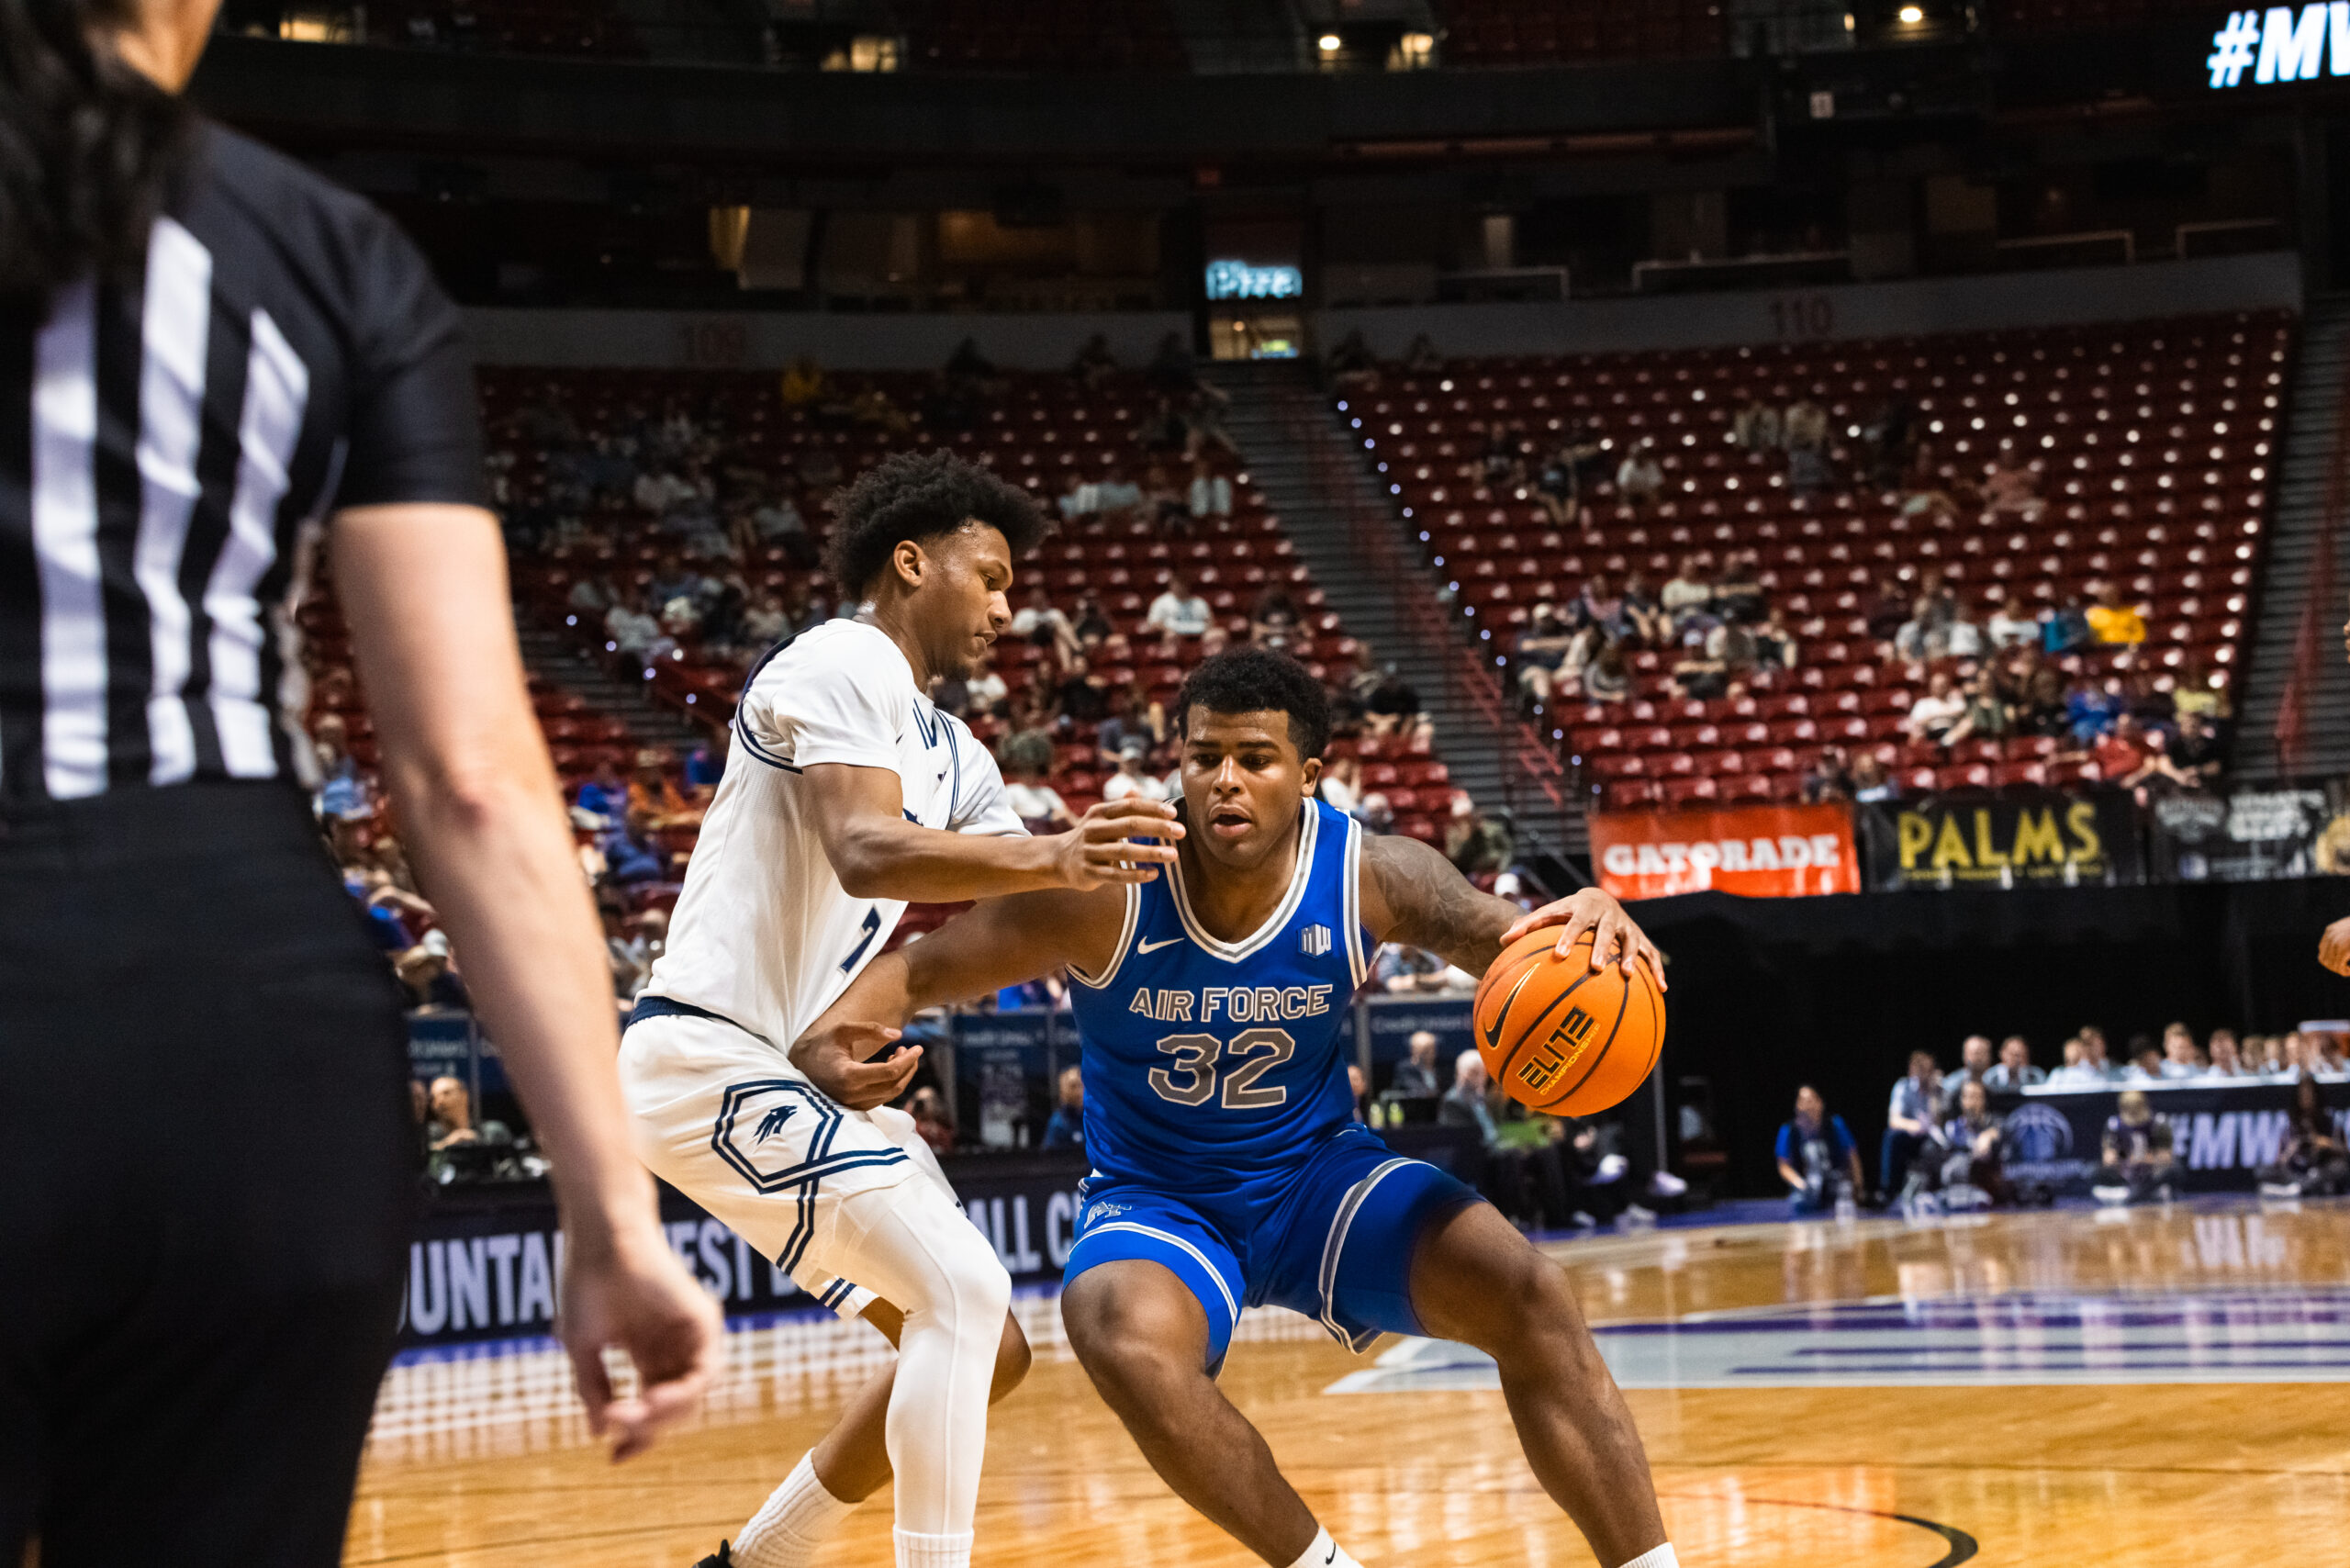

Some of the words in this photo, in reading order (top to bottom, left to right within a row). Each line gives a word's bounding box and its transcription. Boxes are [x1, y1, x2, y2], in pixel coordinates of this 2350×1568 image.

[1604, 834, 1840, 876] GATORADE
[1897, 801, 2100, 869] PALMS
[1128, 987, 1195, 1022] AIR
[1200, 984, 1333, 1023] FORCE
[1147, 1027, 1296, 1109] 32
[1516, 1004, 1595, 1091] ELITE
[1539, 1023, 1601, 1096] CHAMPIONSHIP
[666, 1217, 753, 1301] EST
